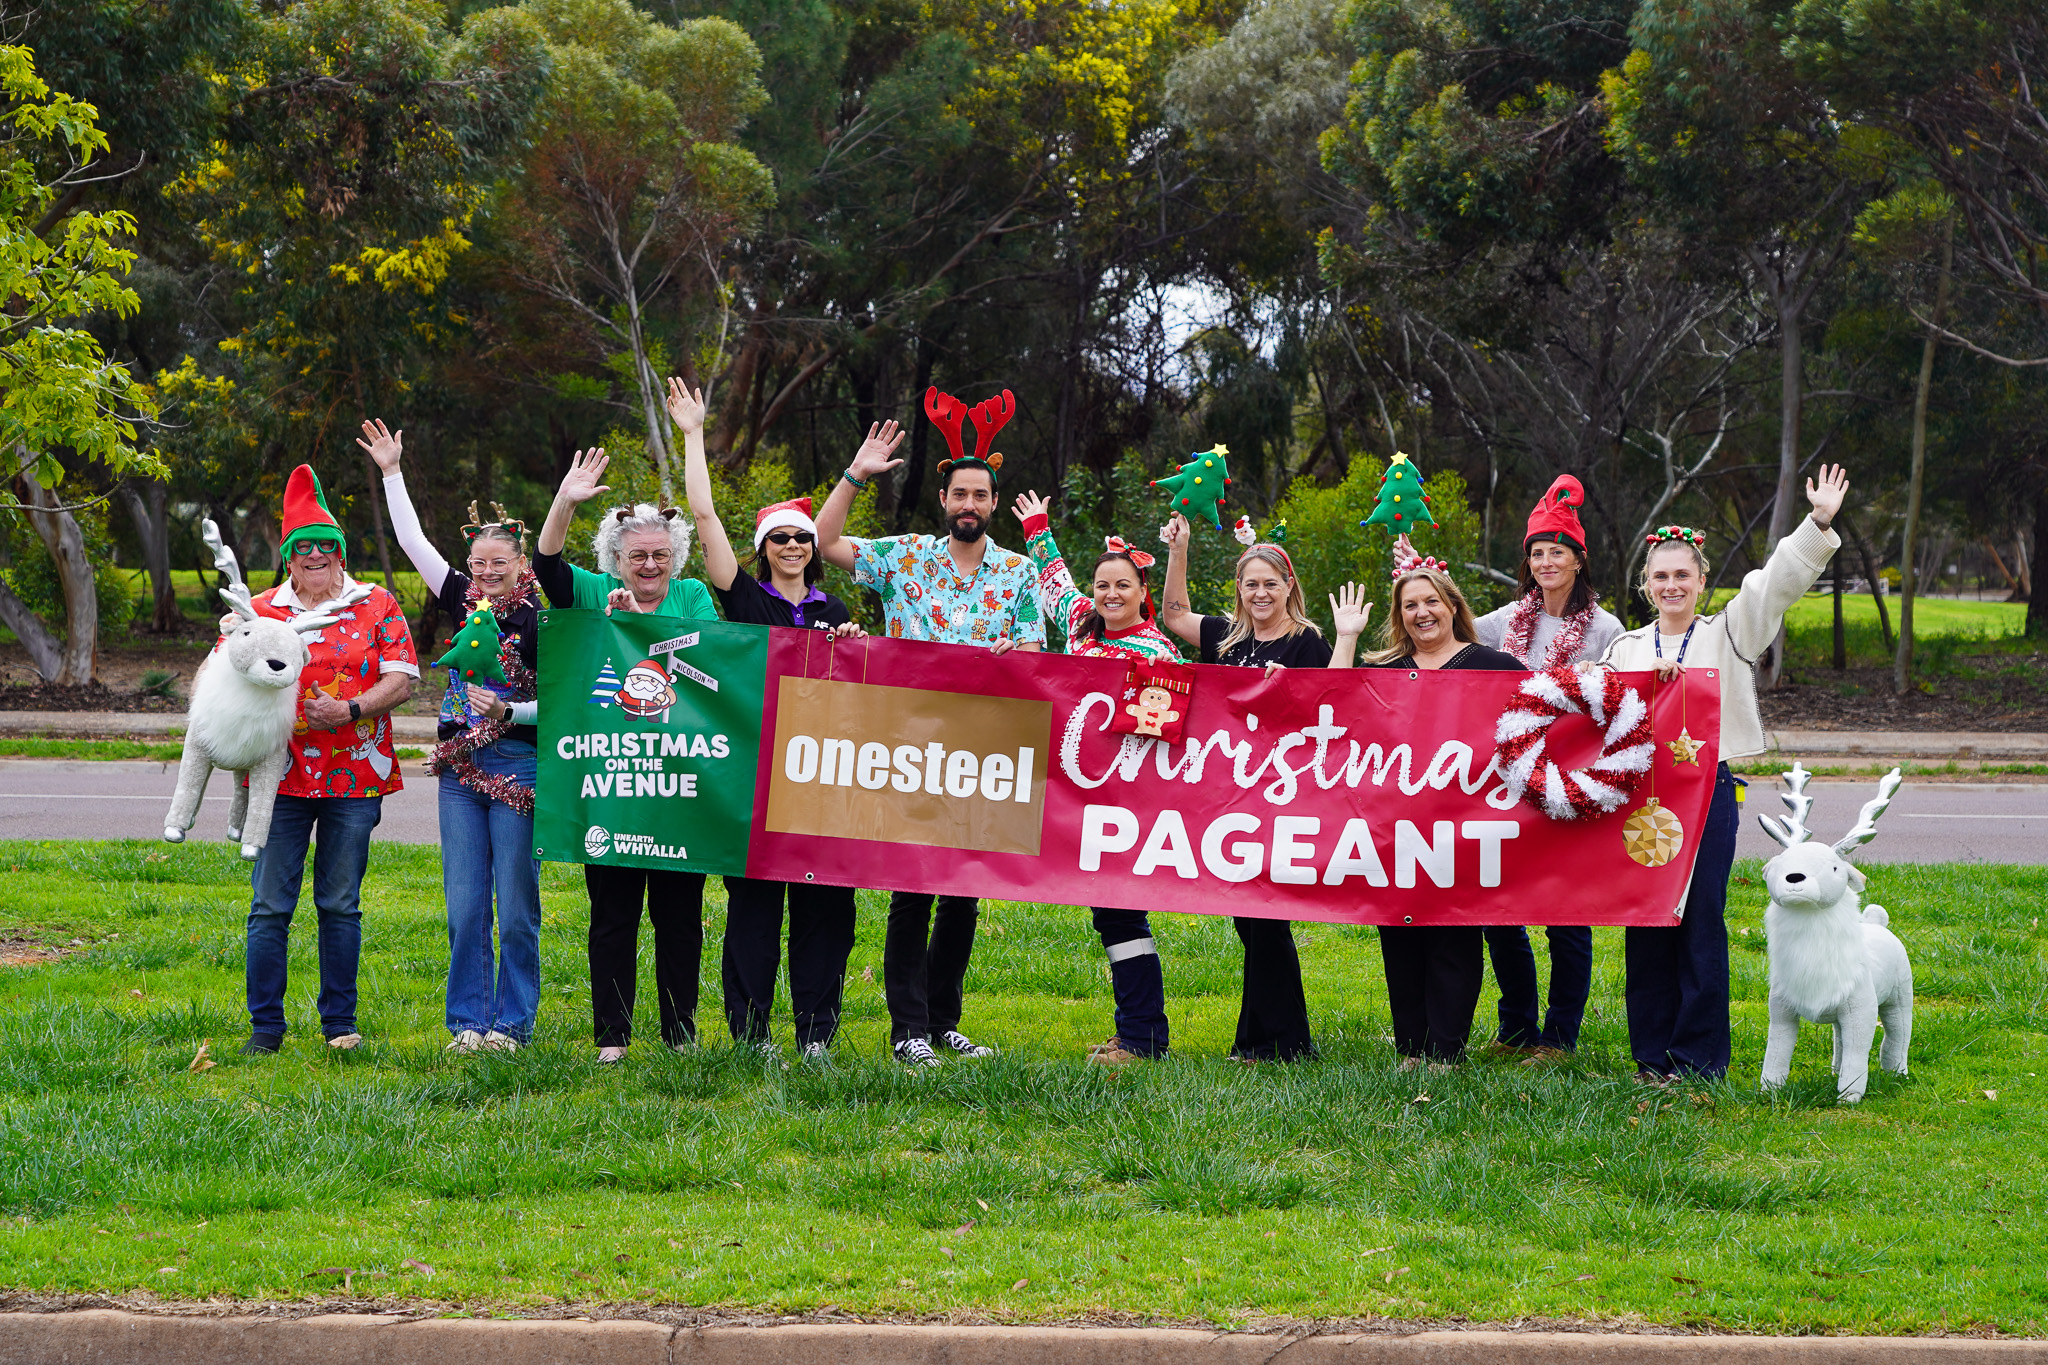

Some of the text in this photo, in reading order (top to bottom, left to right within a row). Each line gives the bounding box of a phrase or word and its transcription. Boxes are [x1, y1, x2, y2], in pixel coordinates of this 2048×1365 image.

[655, 636, 692, 653] CHRISTMAS
[676, 662, 706, 684] NICOLSON
[557, 733, 730, 759] CHRISTMAS
[605, 758, 663, 771] ON THE
[785, 735, 1034, 803] onesteel
[581, 773, 698, 799] AVENUE
[614, 833, 654, 844] UNEARTH
[1079, 804, 1520, 889] PAGEANT
[614, 842, 688, 860] WHYALLA
